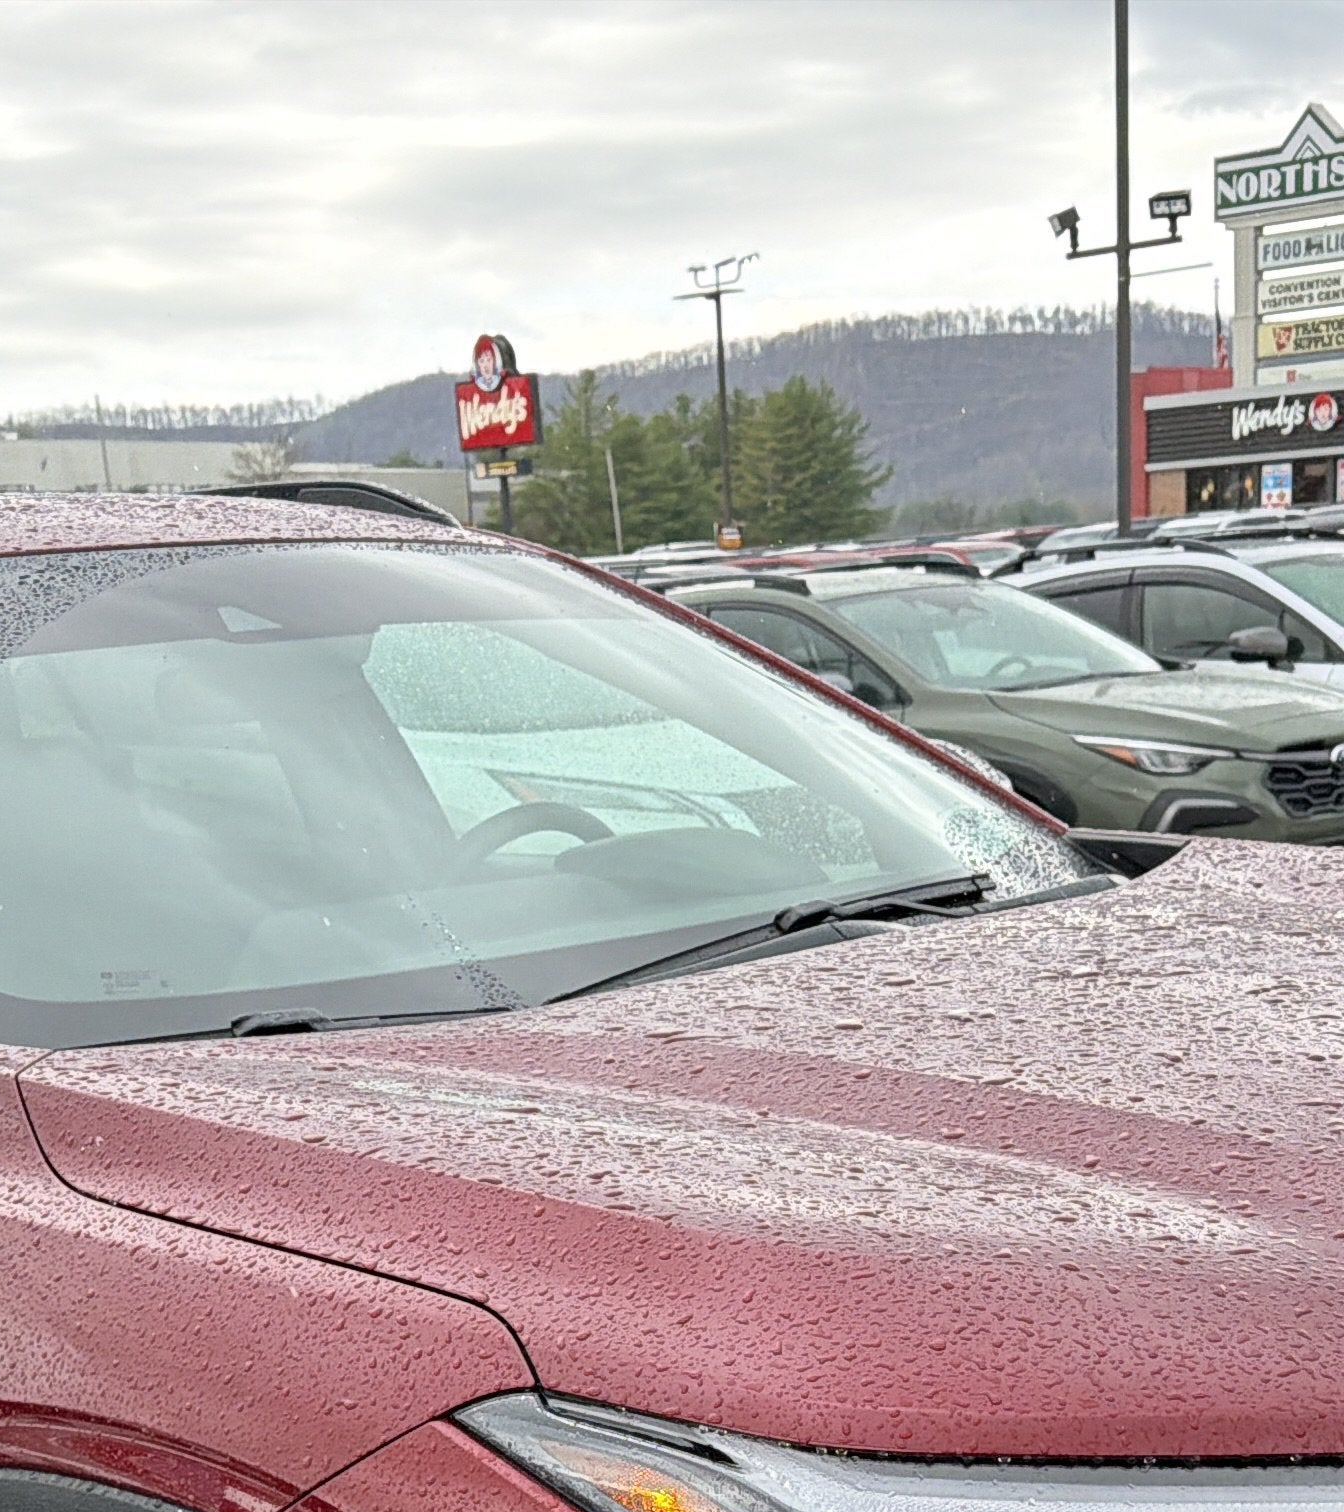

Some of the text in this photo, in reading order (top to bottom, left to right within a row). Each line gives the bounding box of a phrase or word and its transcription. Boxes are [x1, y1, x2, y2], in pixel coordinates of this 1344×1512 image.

[1262, 239, 1302, 262] FOOD
[1268, 276, 1341, 295] CONVENTION
[1261, 292, 1314, 309] VISITOR'S
[1293, 333, 1334, 351] SUPPLY
[459, 384, 528, 440] Wendy's
[1231, 394, 1306, 440] Wendy's
